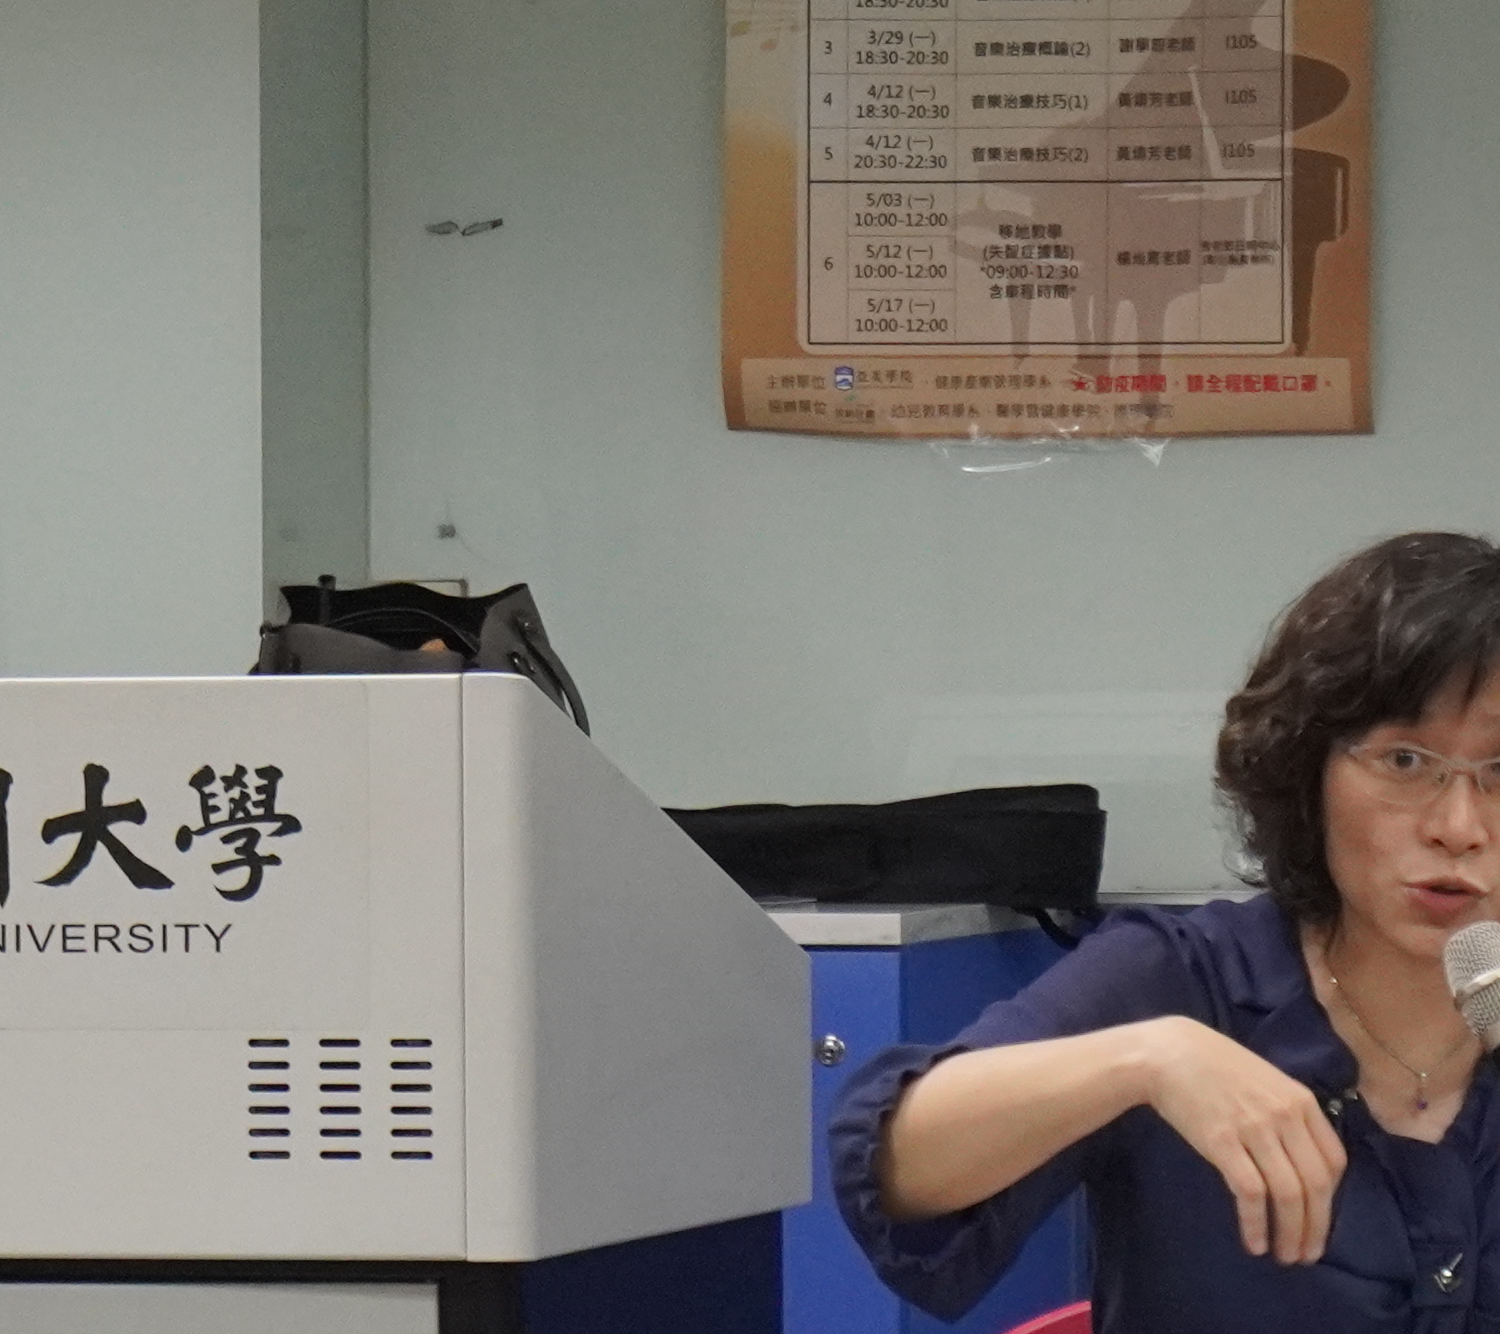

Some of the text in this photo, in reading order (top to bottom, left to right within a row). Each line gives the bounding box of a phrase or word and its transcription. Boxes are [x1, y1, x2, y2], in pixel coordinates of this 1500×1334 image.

[824, 29, 936, 54] 3 3/29 (一)
[855, 50, 949, 65] 18:30-20:30
[823, 84, 936, 106] 4 4/12 (一)
[856, 105, 950, 119] 18:30-20:30
[824, 135, 934, 161] 5 4/12 (一)
[854, 154, 947, 169] 20:30-22:30
[866, 193, 935, 209] 5/03 (一)
[855, 212, 948, 227] 10:00-12:00
[824, 245, 934, 271] 6 5/12 (一)
[854, 265, 948, 279] 10:00-12:00
[867, 298, 936, 314] 5/17 (一)
[855, 318, 949, 333] 10:00-12:00
